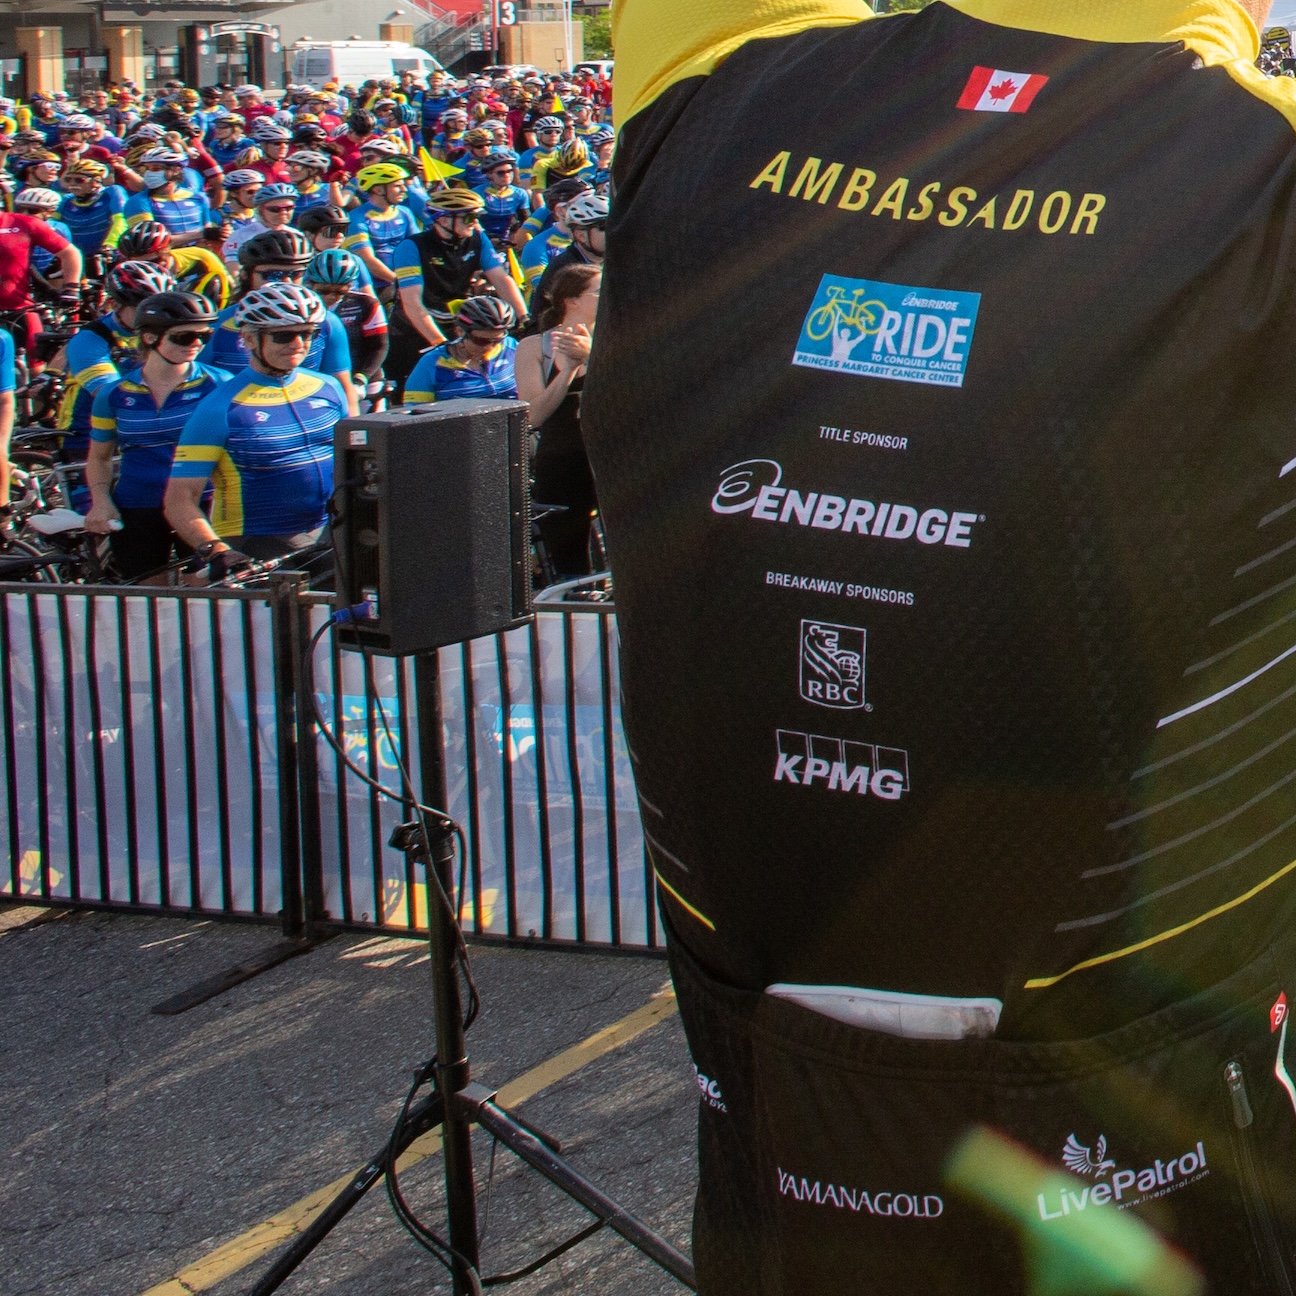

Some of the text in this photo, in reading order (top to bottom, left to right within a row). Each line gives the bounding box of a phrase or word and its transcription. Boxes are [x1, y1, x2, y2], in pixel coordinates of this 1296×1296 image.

[501, 2, 516, 25] 3
[750, 151, 1107, 235] AMBASSADOR
[909, 296, 960, 312] ENBRIDGE
[872, 310, 972, 361] RIDE
[796, 354, 960, 384] PRINCESS MARGARET CANCER CENTRE
[871, 353, 962, 371] TO CONQUER CANCER
[819, 426, 908, 450] TITLE SPONSOR
[751, 484, 978, 548] ENBRIDGE
[765, 571, 915, 606] BREAKAWAY SPONSORS
[807, 679, 859, 704] RBC
[773, 753, 904, 801] KPMG
[777, 1166, 944, 1218] YAMANAGOLD
[1037, 1141, 1207, 1222] LivePatrol
[1117, 1169, 1210, 1211] www.livepatrol.com
